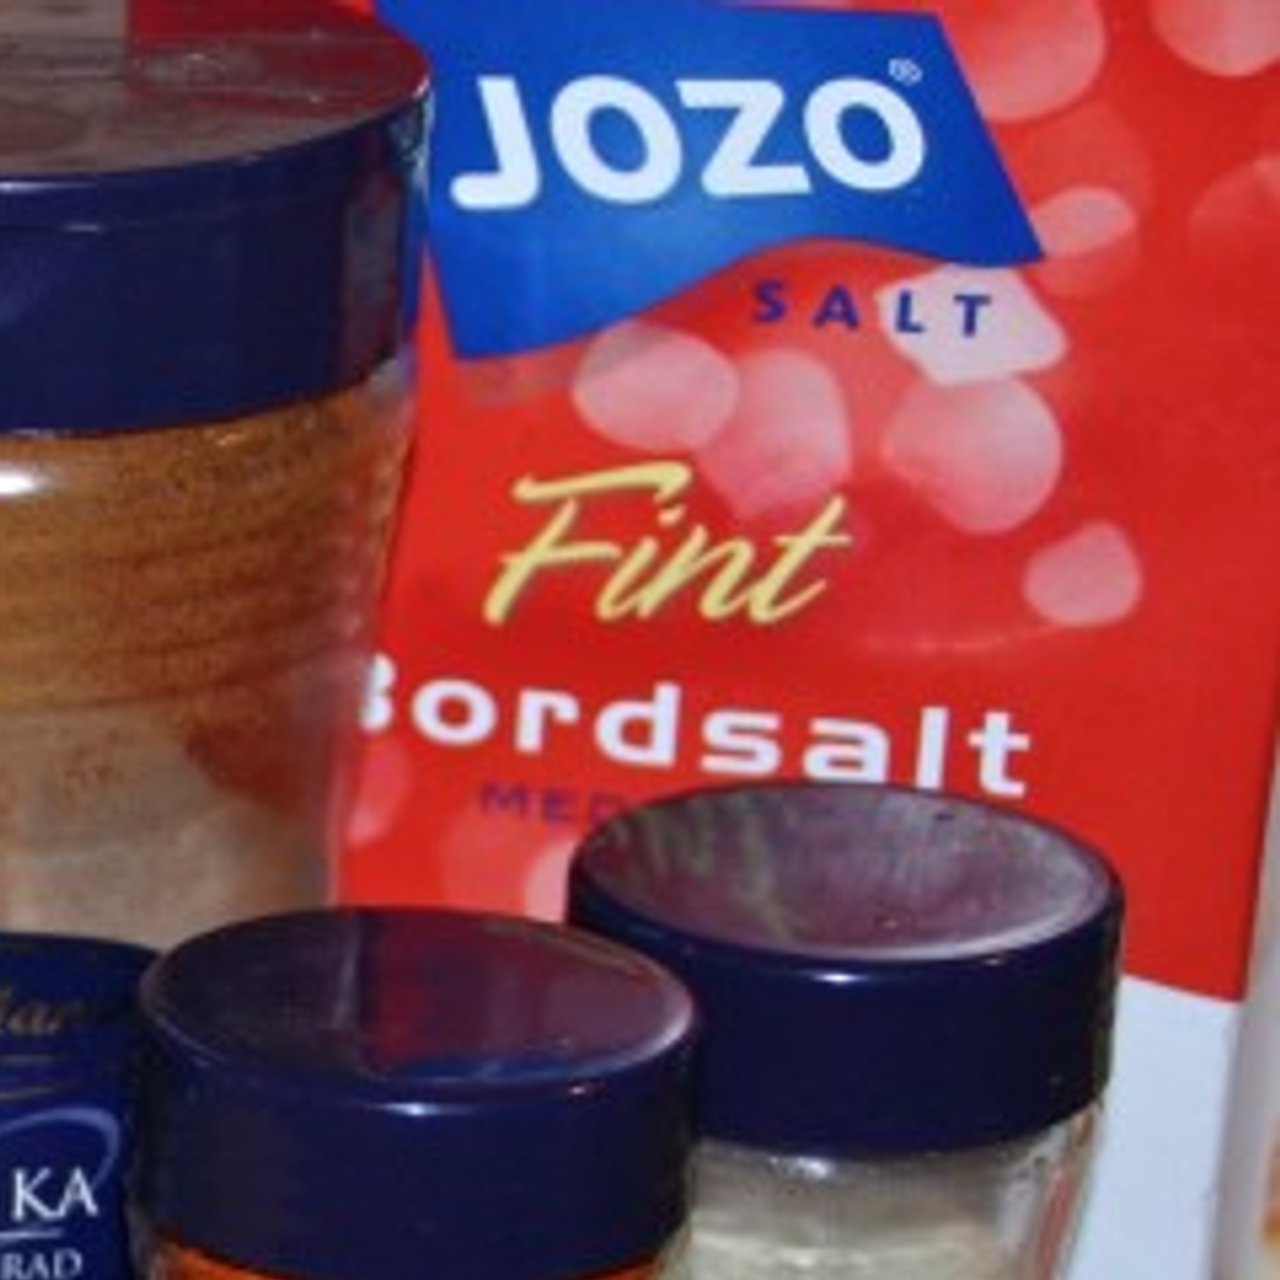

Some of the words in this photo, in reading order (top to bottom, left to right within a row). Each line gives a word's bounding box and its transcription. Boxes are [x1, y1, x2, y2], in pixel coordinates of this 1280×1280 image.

[449, 74, 927, 211] JOZO
[751, 280, 993, 339] SALT
[482, 461, 852, 624] Fint
